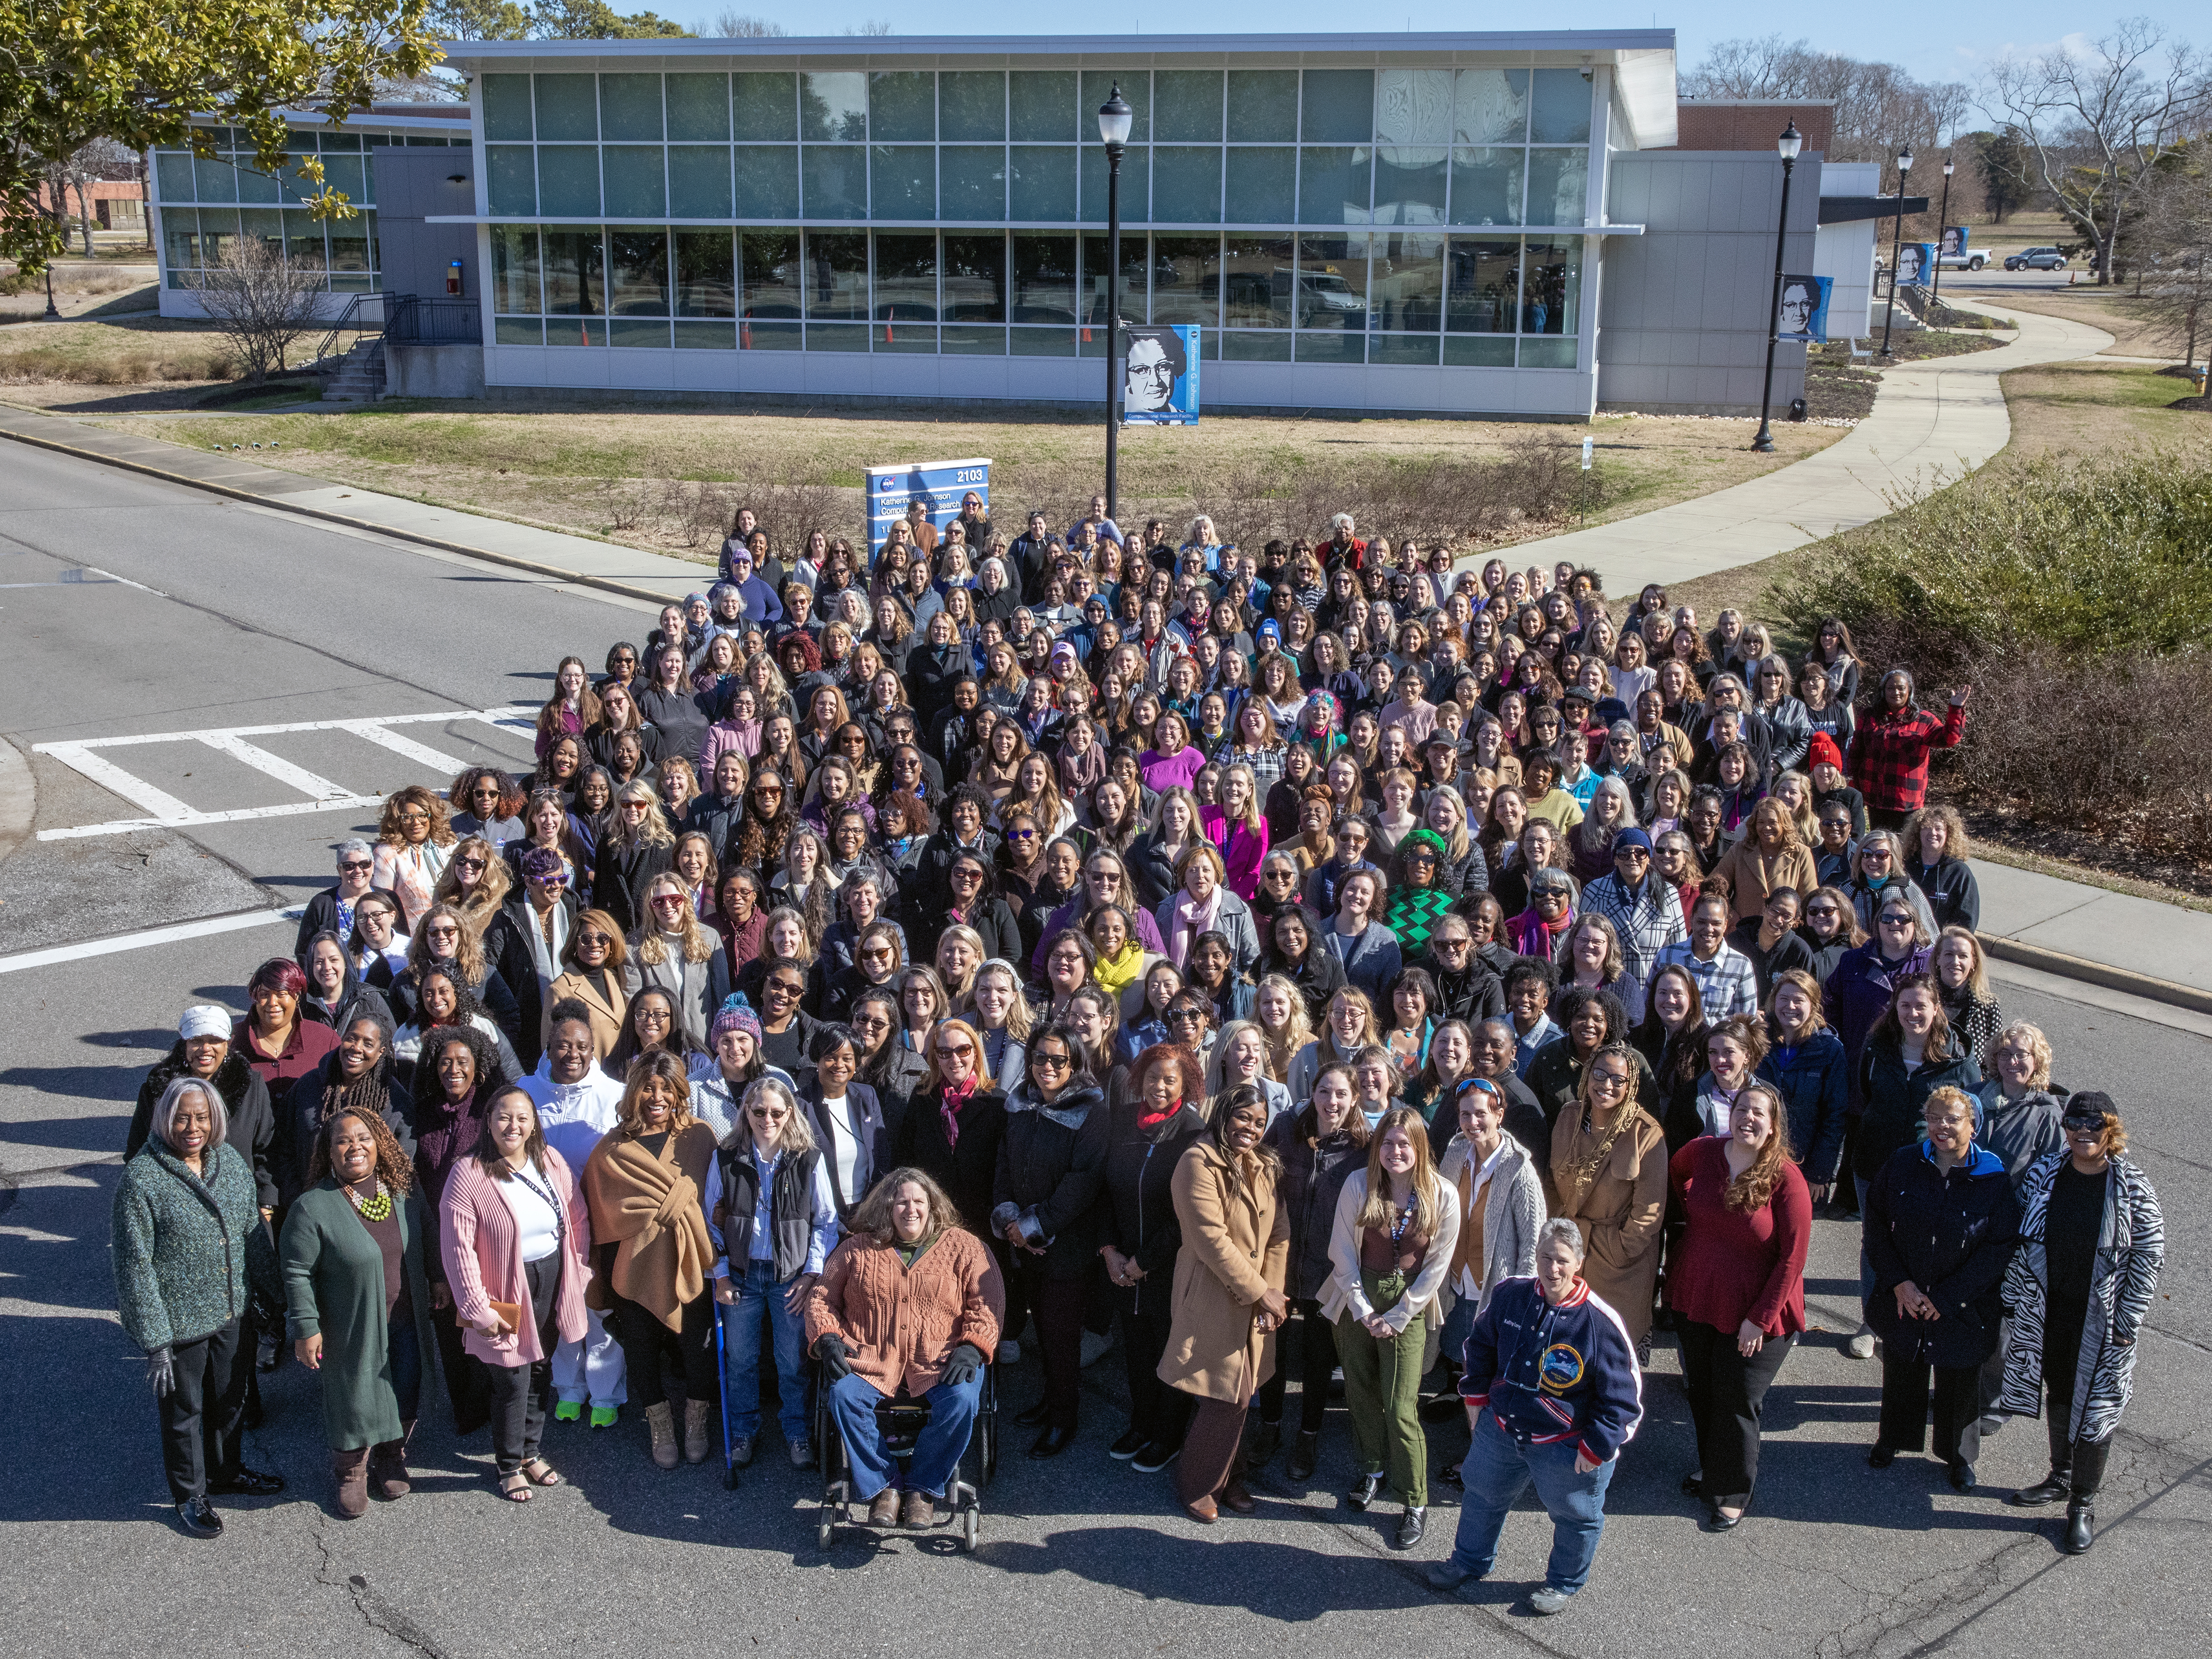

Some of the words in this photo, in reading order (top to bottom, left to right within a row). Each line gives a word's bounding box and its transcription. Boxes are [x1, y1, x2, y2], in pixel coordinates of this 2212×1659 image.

[957, 469, 983, 483] 2103
[880, 496, 912, 506] Katherine
[930, 500, 960, 510] Research
[788, 1017, 798, 1029] Jacobs
[526, 1180, 538, 1192] NASA
